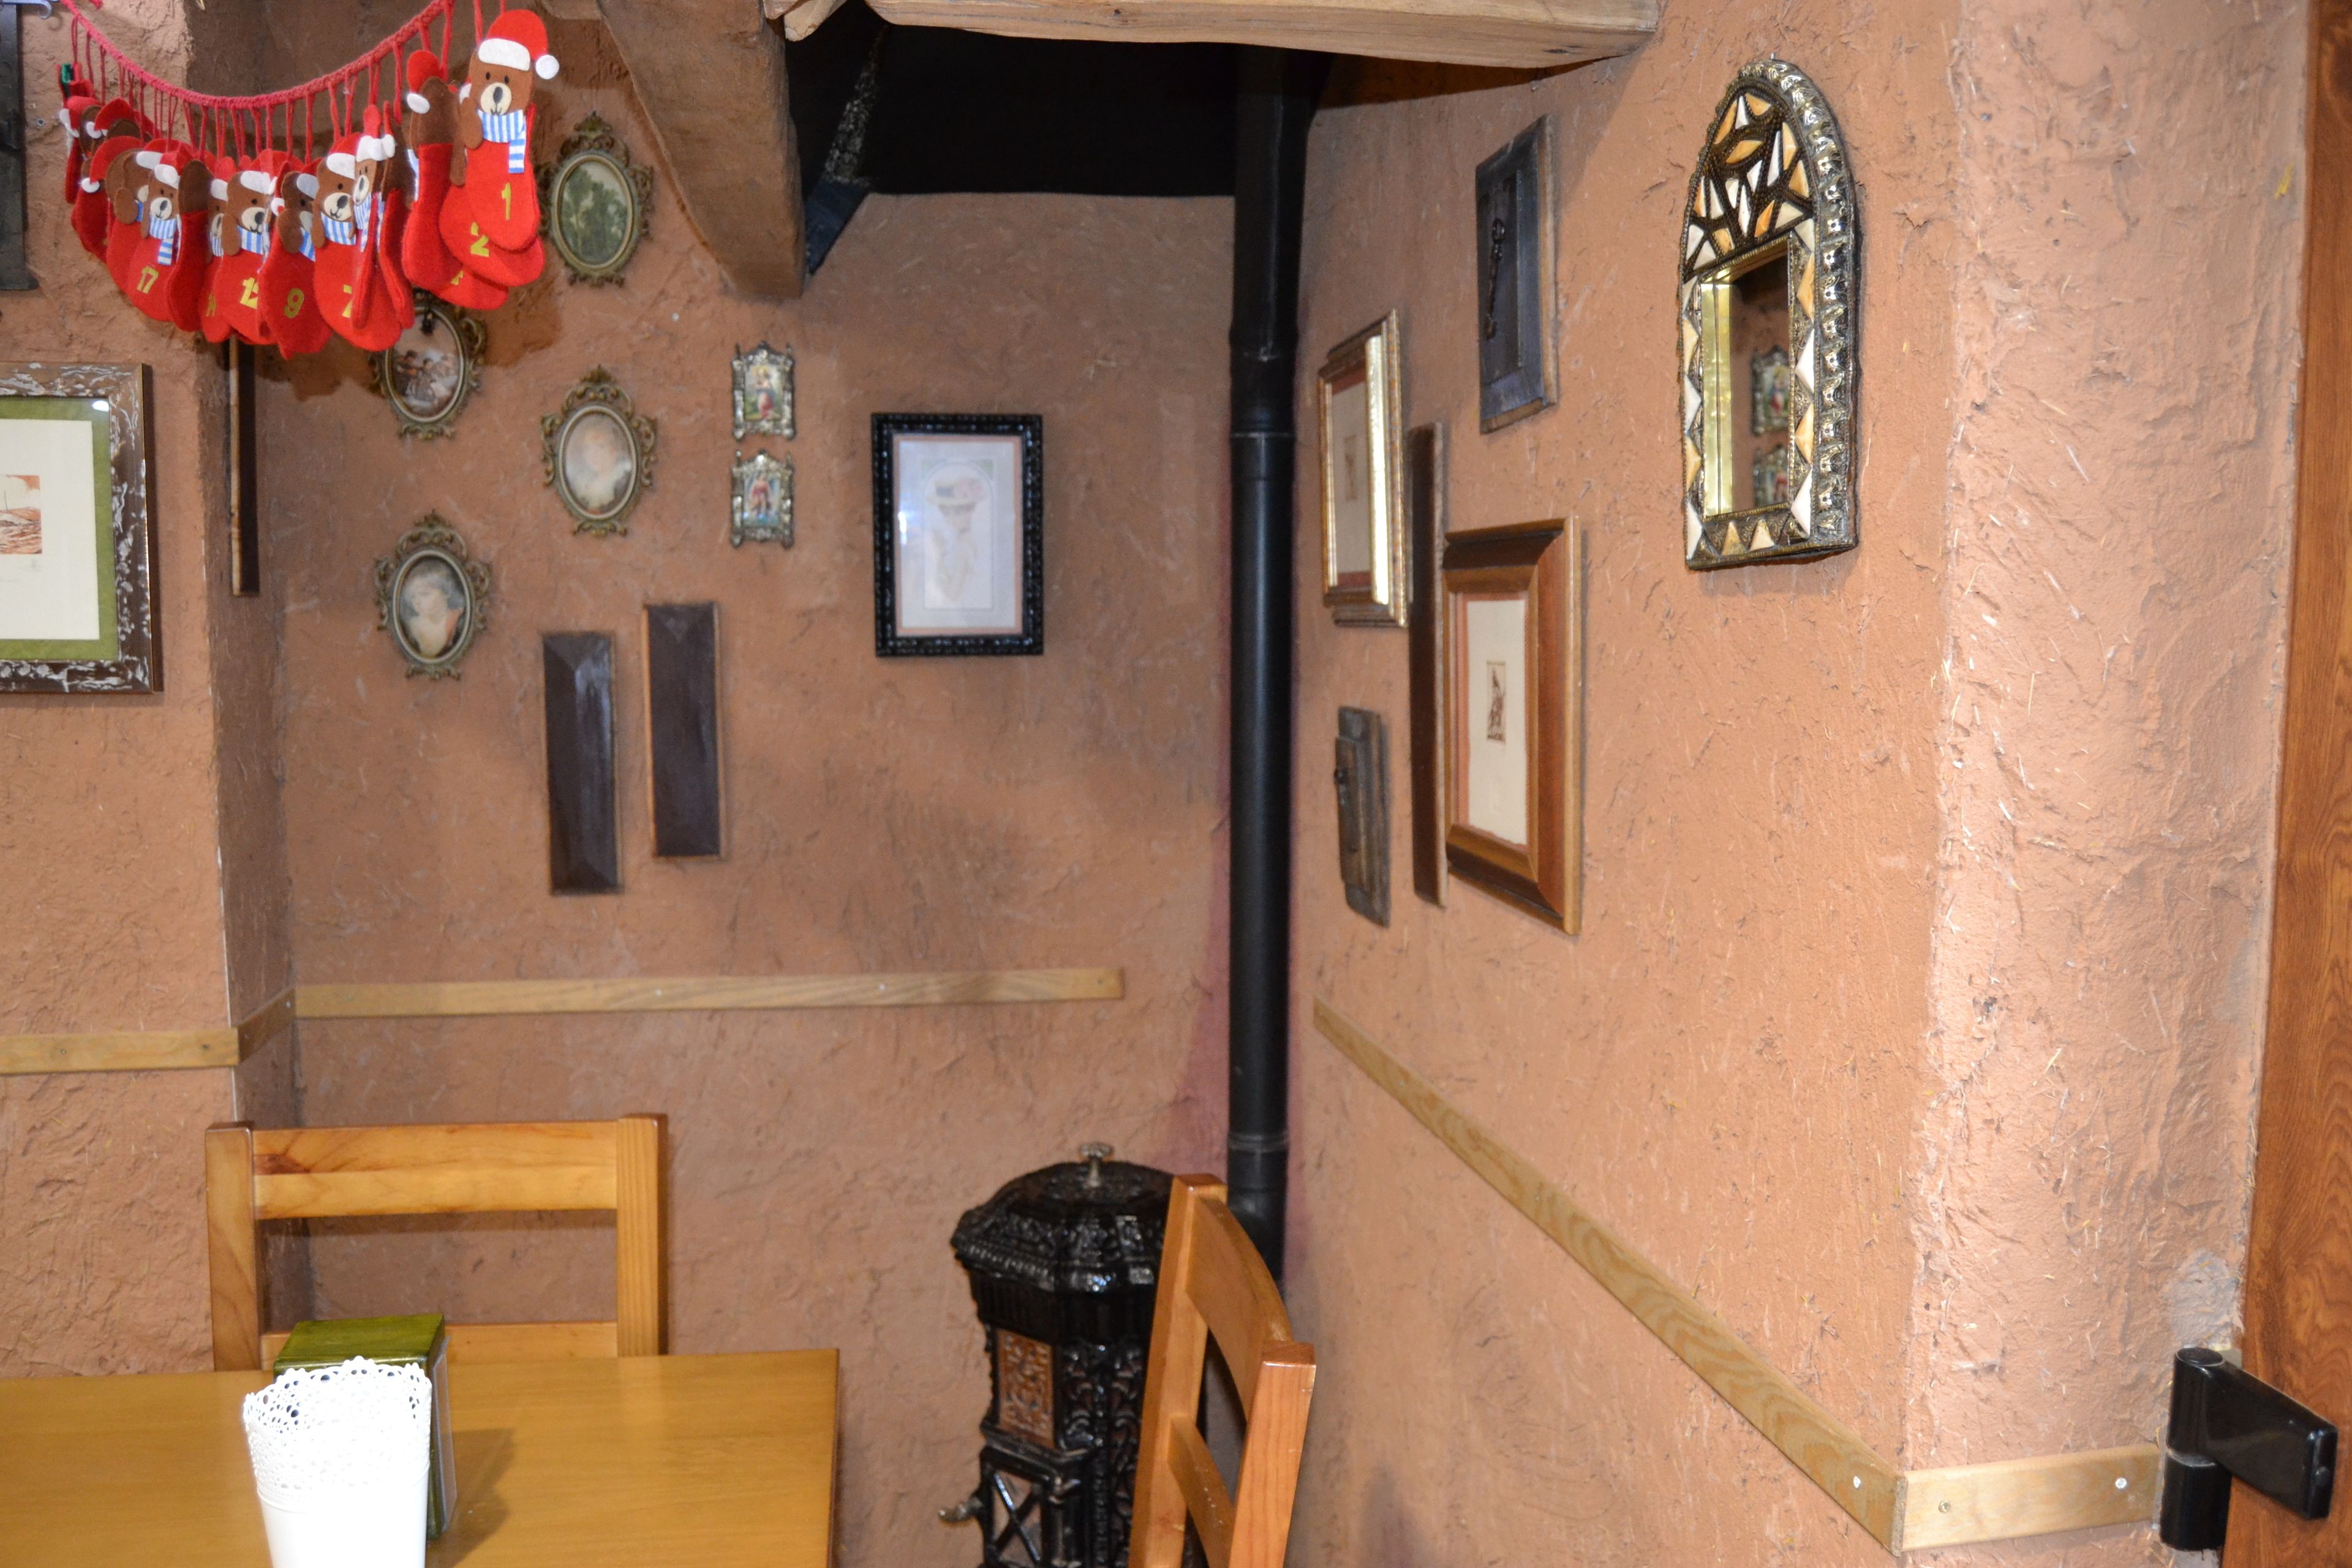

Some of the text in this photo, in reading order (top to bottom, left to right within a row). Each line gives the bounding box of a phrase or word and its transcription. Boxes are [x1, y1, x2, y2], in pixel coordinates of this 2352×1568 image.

[501, 183, 511, 221] 1
[470, 222, 490, 257] 2
[137, 265, 159, 294] 17
[284, 287, 304, 318] 9
